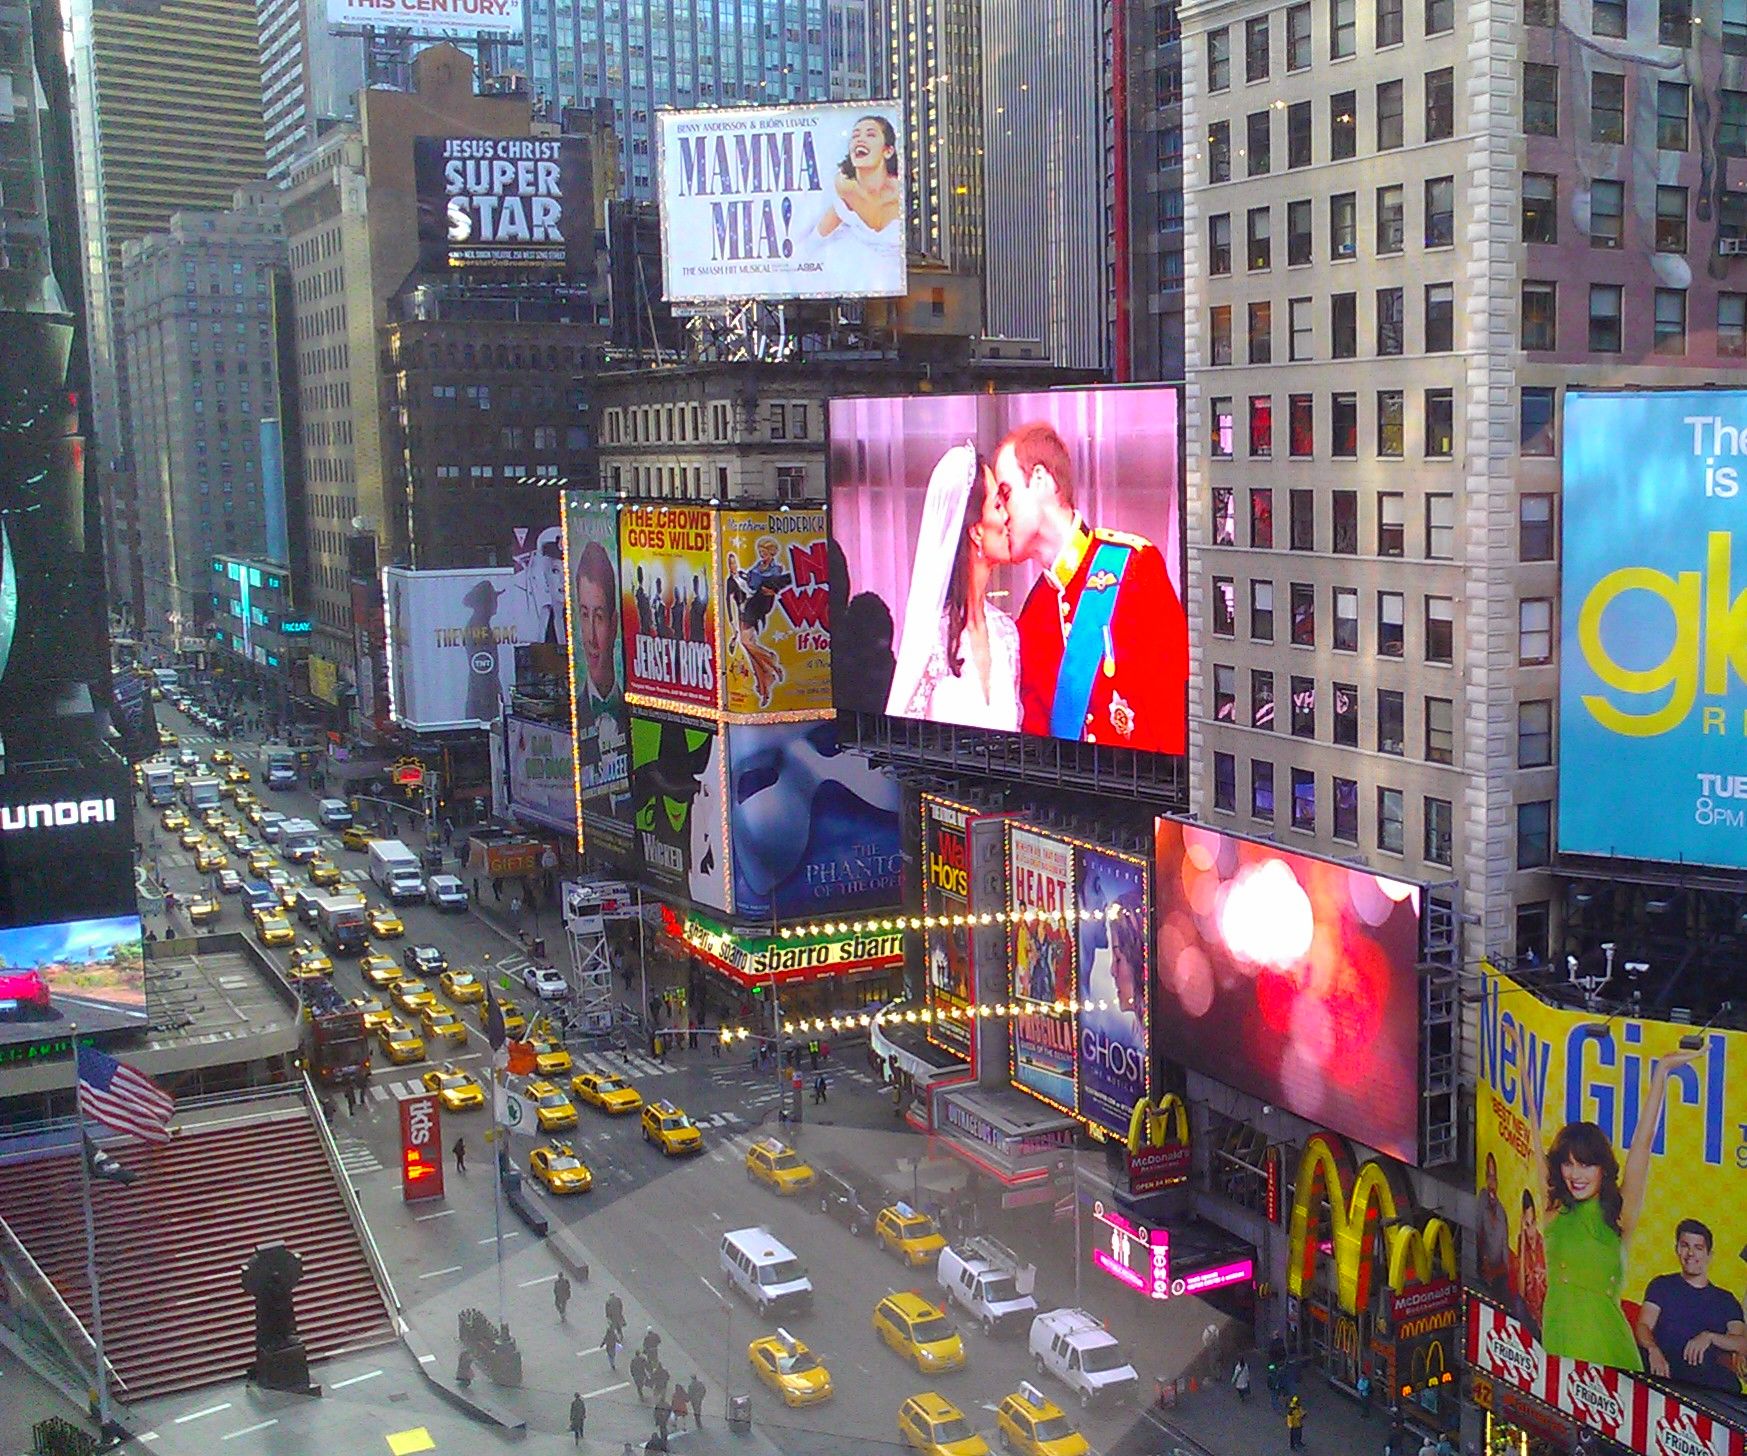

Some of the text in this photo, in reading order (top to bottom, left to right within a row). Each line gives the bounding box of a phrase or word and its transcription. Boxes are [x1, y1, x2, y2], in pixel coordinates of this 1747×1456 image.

[703, 122, 747, 132] ANDERSSON
[751, 121, 756, 129] &
[443, 140, 561, 159] JESUS CHRIST
[678, 131, 823, 197] MAMMA
[445, 160, 563, 197] SUPER
[447, 196, 565, 242] STAR
[710, 196, 793, 261] MIA!
[683, 266, 695, 275] THE
[698, 265, 723, 275] SMASH
[725, 264, 737, 274] HIT
[740, 264, 771, 274] MUSICAL
[1705, 457, 1739, 498] is
[656, 511, 711, 530] CROWD
[768, 515, 825, 534] BRODERICK
[628, 528, 665, 549] GOES
[797, 634, 810, 650] If
[1578, 531, 1747, 737] gl
[475, 659, 491, 668] TNT
[634, 634, 713, 690] JERSEY BOYS
[1695, 797, 1744, 827] 8PM
[642, 831, 684, 871] WICKED
[852, 843, 880, 856] THE
[813, 884, 832, 898] OF
[838, 881, 867, 896] THE
[1016, 866, 1067, 913] HEART
[718, 940, 748, 971] sbarro
[753, 944, 829, 973] sbarro
[1082, 1028, 1145, 1083] GHOST
[1479, 971, 1726, 1165] New Girl
[409, 1099, 434, 1145] tkts
[1131, 1149, 1190, 1168] McDonald's
[1136, 1182, 1154, 1191] OPEN
[1394, 1284, 1457, 1310] McDonald's
